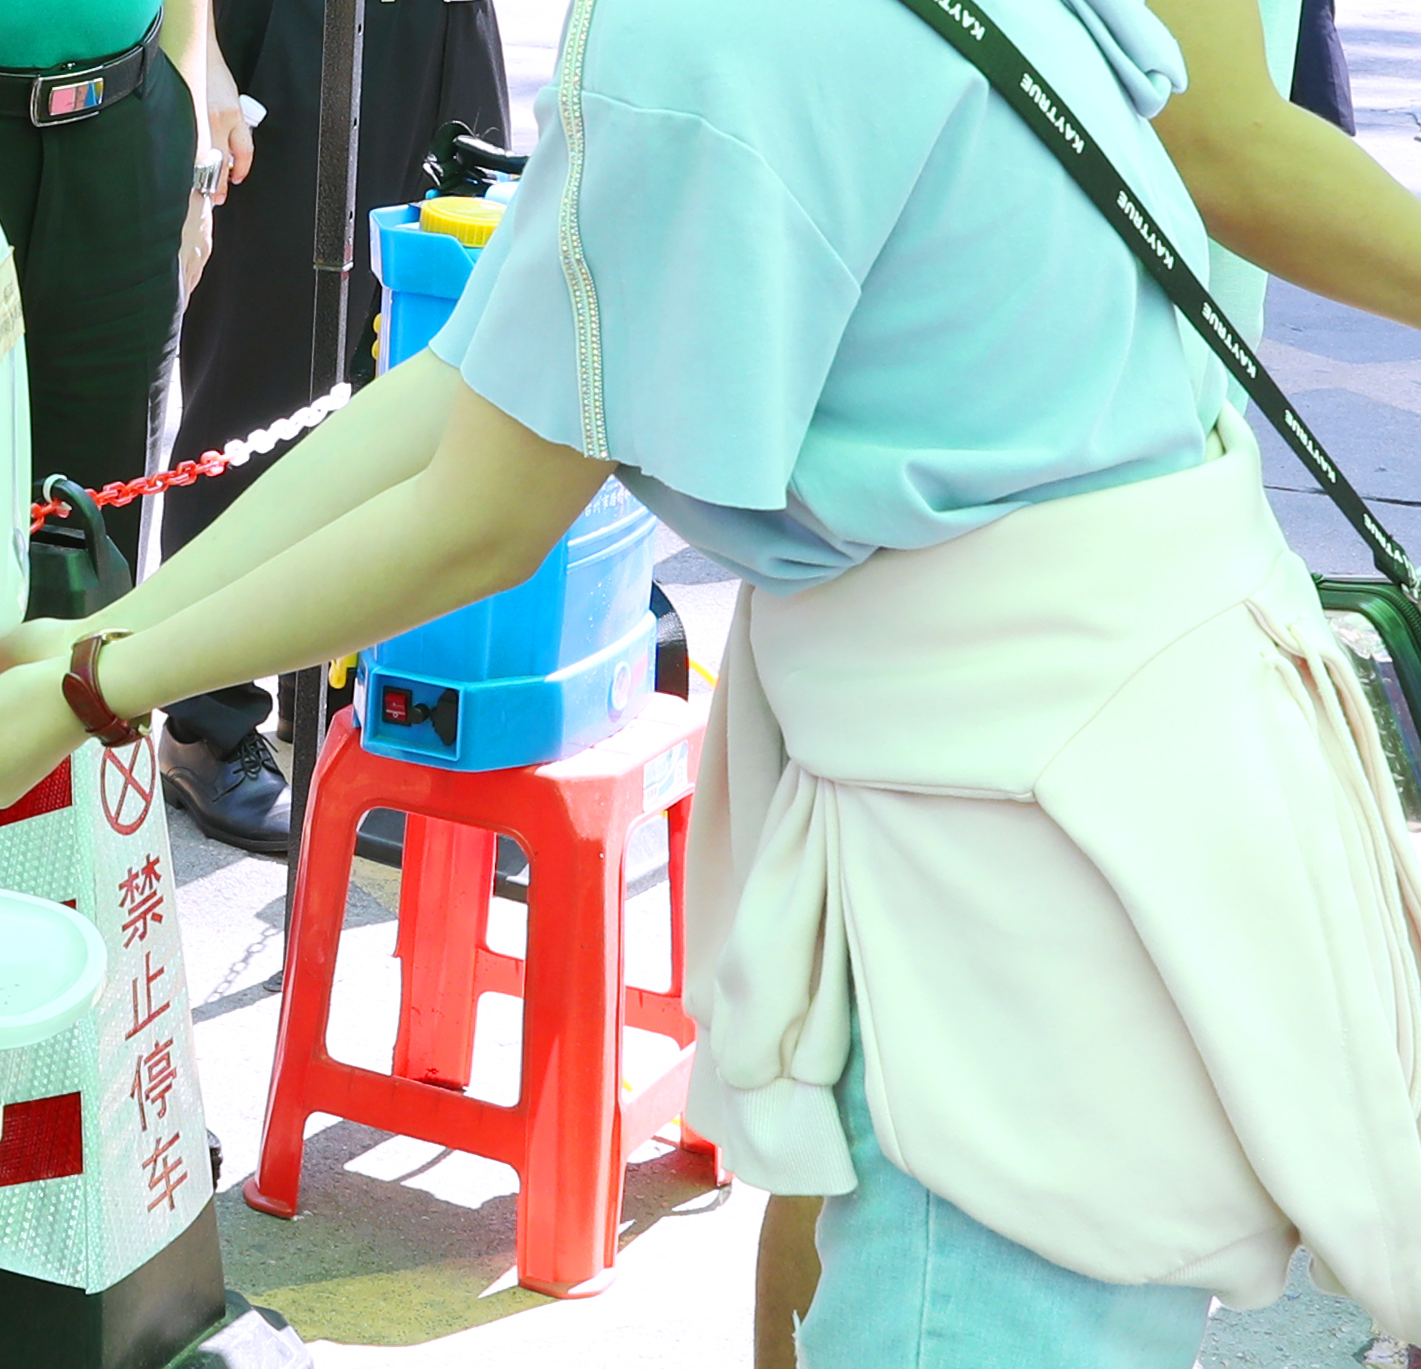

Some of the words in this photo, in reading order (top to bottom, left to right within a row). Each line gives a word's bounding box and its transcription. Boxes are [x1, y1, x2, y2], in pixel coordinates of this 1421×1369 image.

[1019, 72, 1085, 154] KAYTRUE
[1116, 189, 1175, 270] KAYTRUE
[1201, 302, 1258, 378] KAYTRUE
[1285, 409, 1337, 483] KAYTRUE
[115, 853, 187, 1212] 禁止停车
